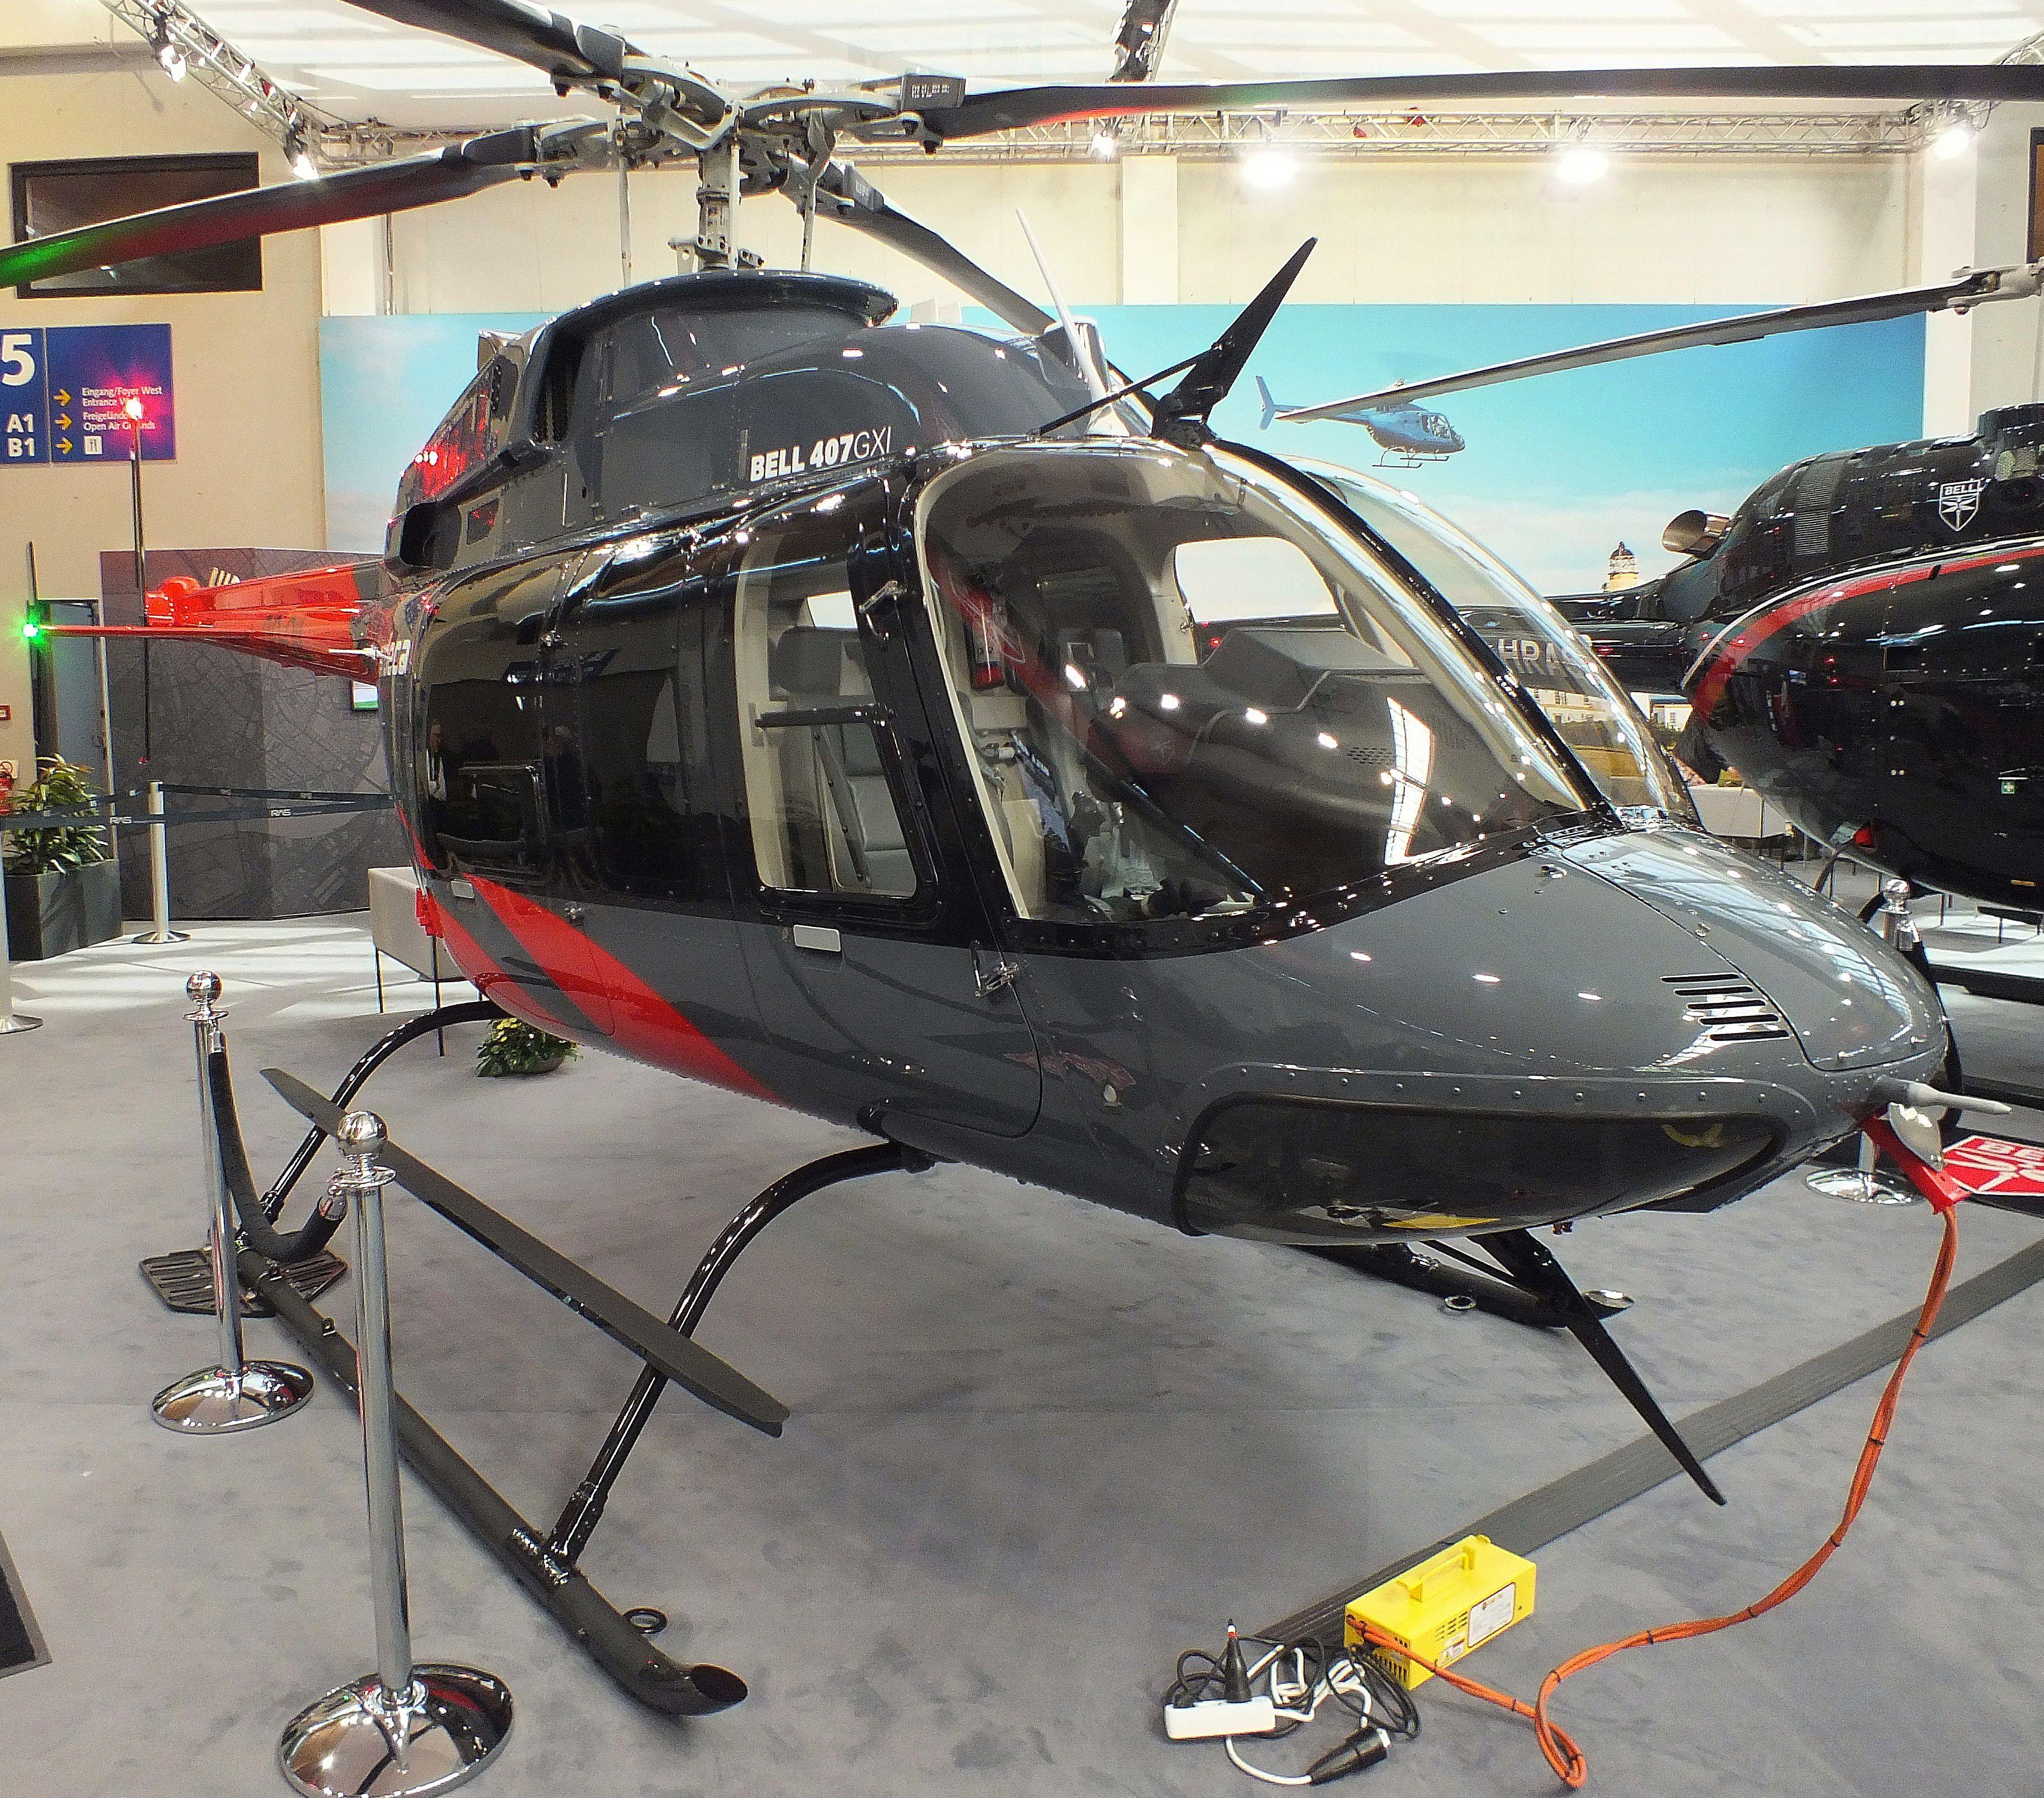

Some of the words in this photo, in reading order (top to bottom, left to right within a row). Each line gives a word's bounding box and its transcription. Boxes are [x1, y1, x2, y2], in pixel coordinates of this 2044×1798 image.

[2, 334, 35, 386] 5
[141, 386, 163, 395] West
[82, 398, 117, 406] Entrance
[7, 414, 34, 434] A1
[84, 423, 107, 433] Open
[108, 422, 120, 430] Air
[122, 422, 156, 430] Grnds
[8, 438, 35, 457] B1
[750, 446, 805, 481] BELL
[1944, 484, 1978, 496] BELL
